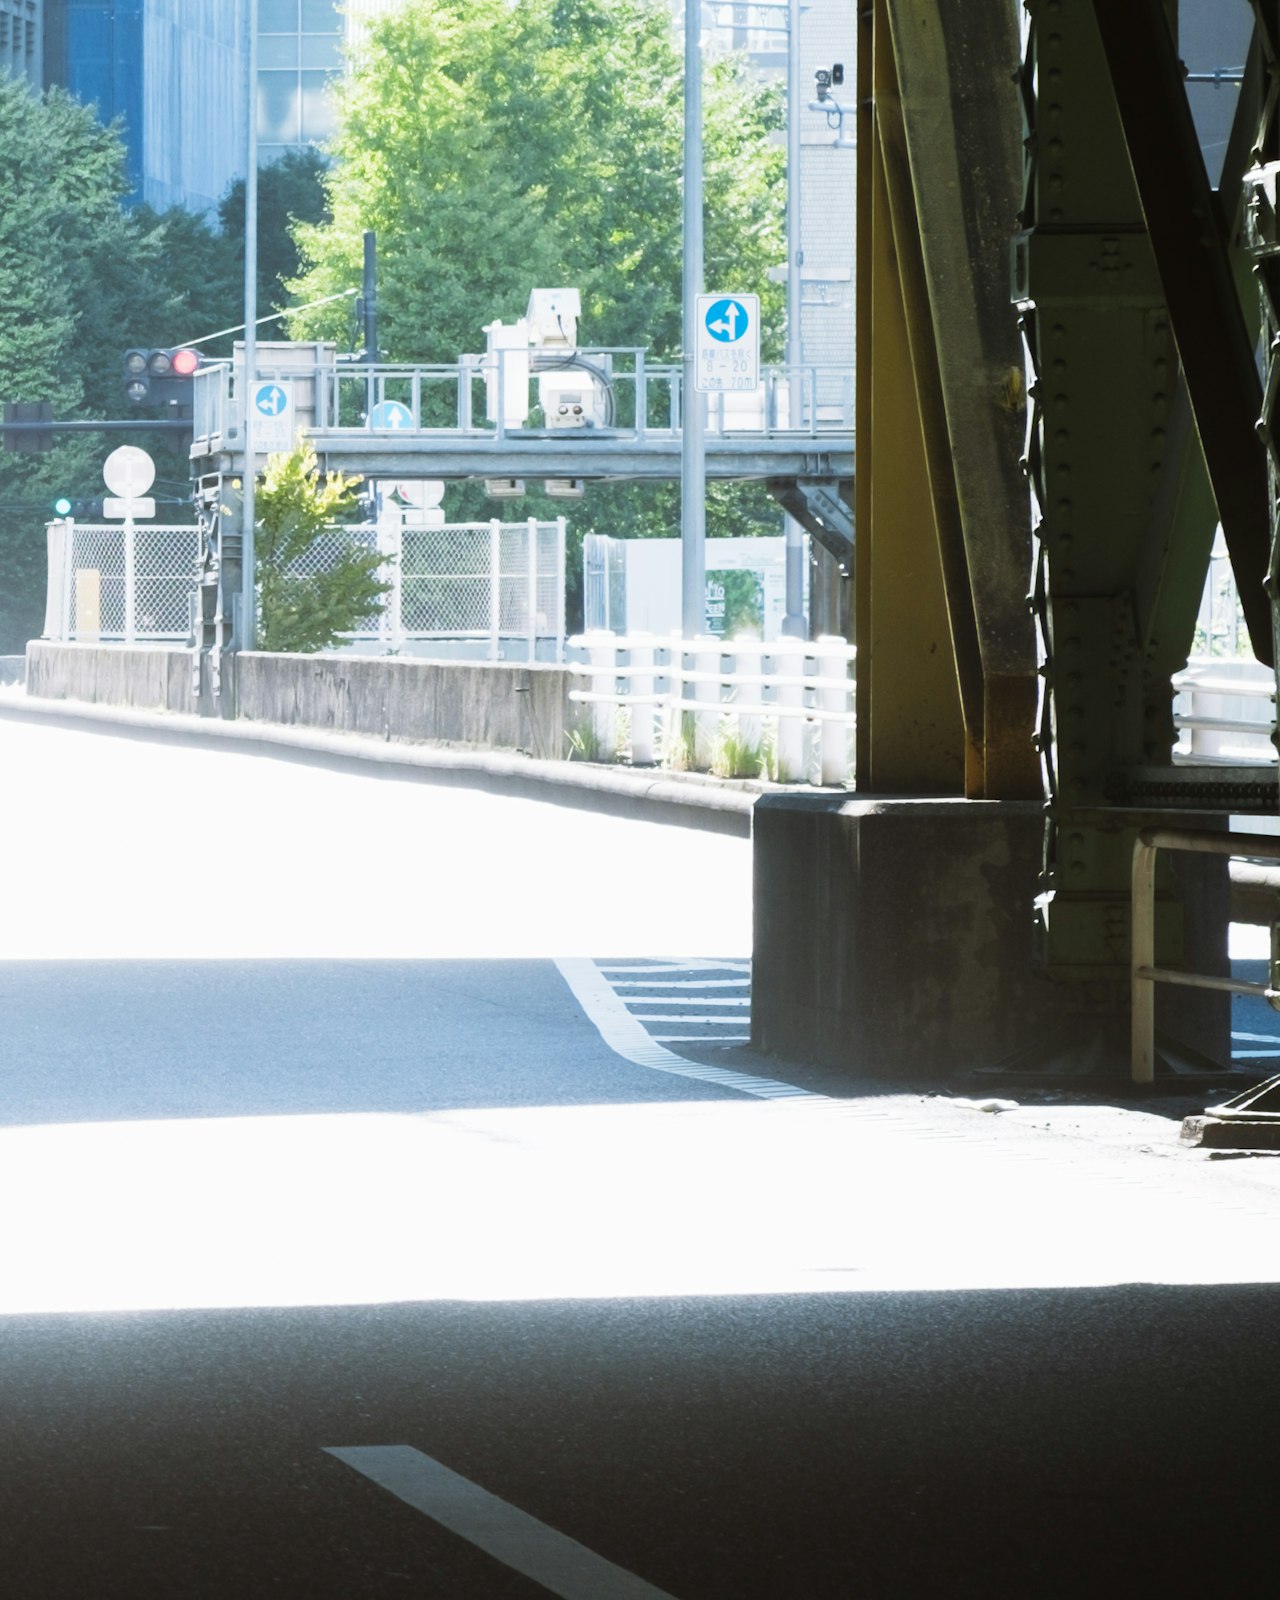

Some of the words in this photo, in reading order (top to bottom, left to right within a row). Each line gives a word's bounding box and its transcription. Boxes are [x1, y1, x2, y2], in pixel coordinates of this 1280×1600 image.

[706, 360, 713, 373] 8
[733, 359, 748, 373] 20
[731, 376, 752, 389] 70m
